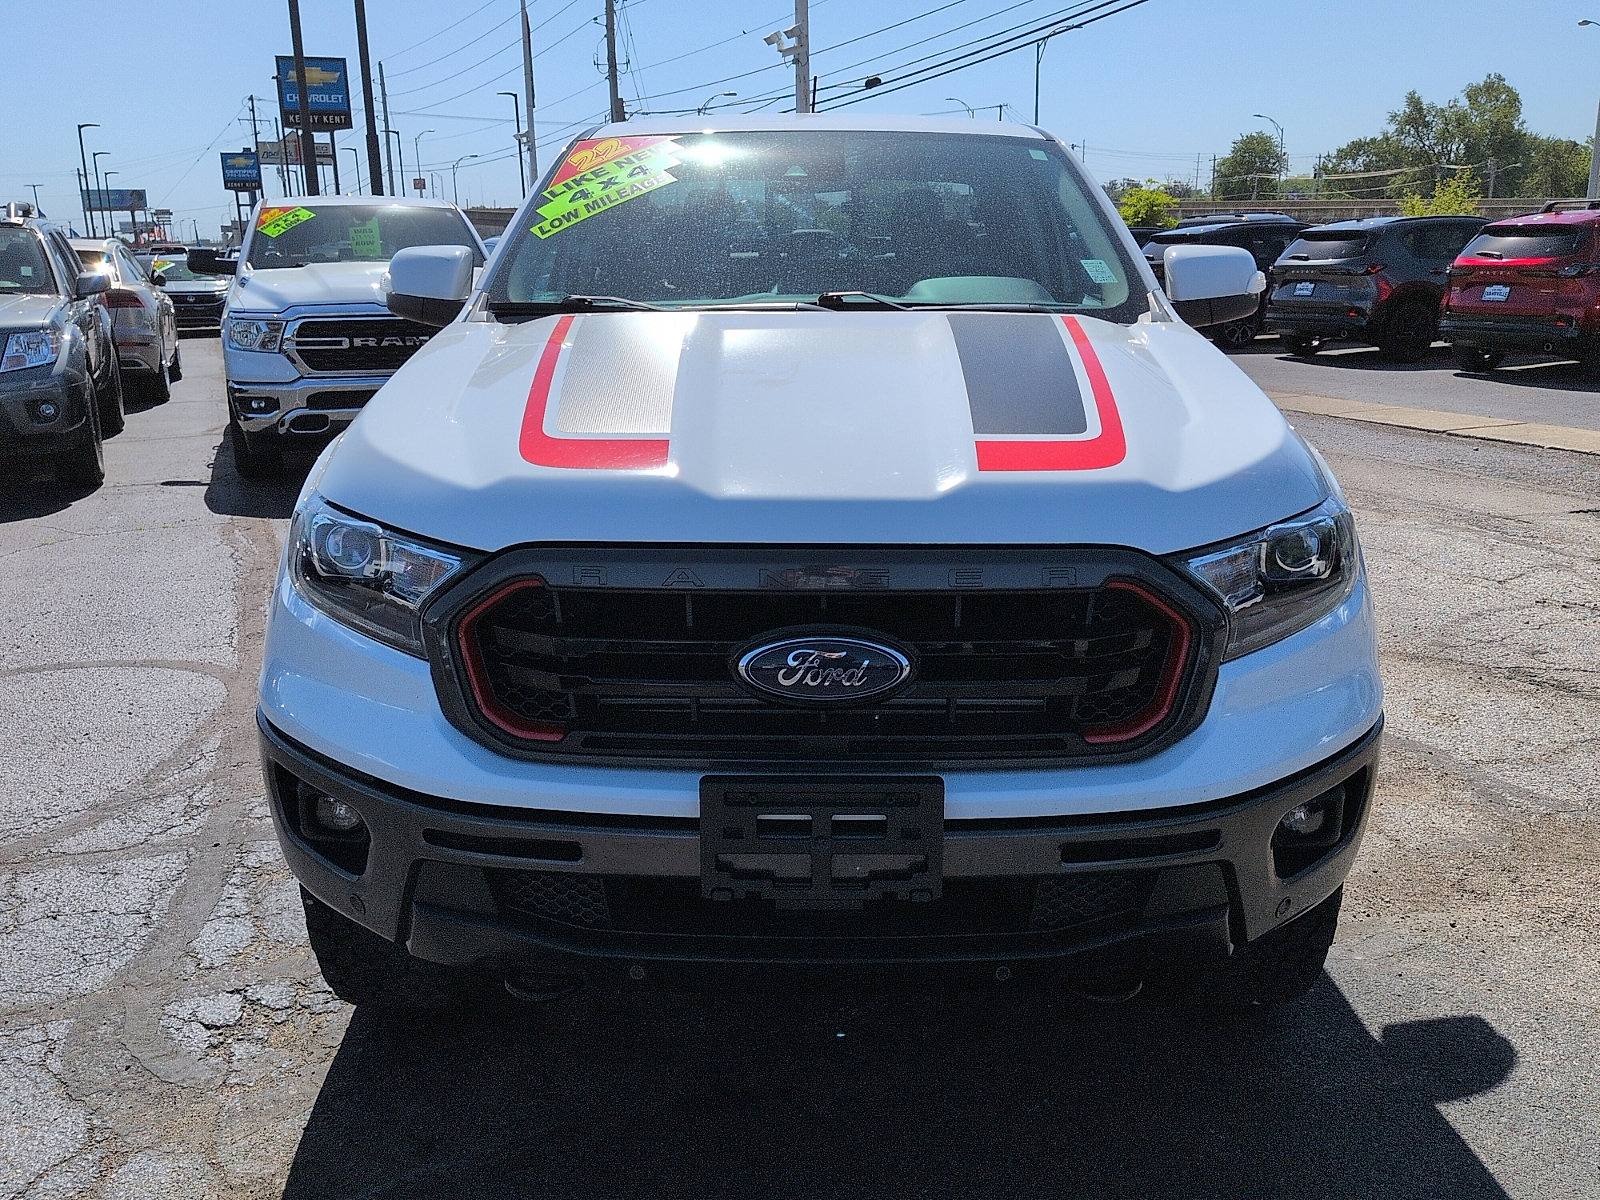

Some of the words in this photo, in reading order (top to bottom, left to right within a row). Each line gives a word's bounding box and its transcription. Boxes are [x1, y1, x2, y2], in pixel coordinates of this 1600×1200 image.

[286, 93, 343, 103] CHVROLET
[289, 114, 319, 123] KENY
[323, 115, 346, 124] KENT
[567, 138, 632, 171] 22
[547, 166, 610, 199] LIKE
[568, 187, 594, 203] 4
[627, 164, 652, 180] 4
[538, 208, 581, 235] LOW
[583, 174, 667, 213] MILEAGE
[353, 336, 429, 347] RAM
[572, 565, 1078, 588] RANGER
[778, 650, 870, 686] Ford
